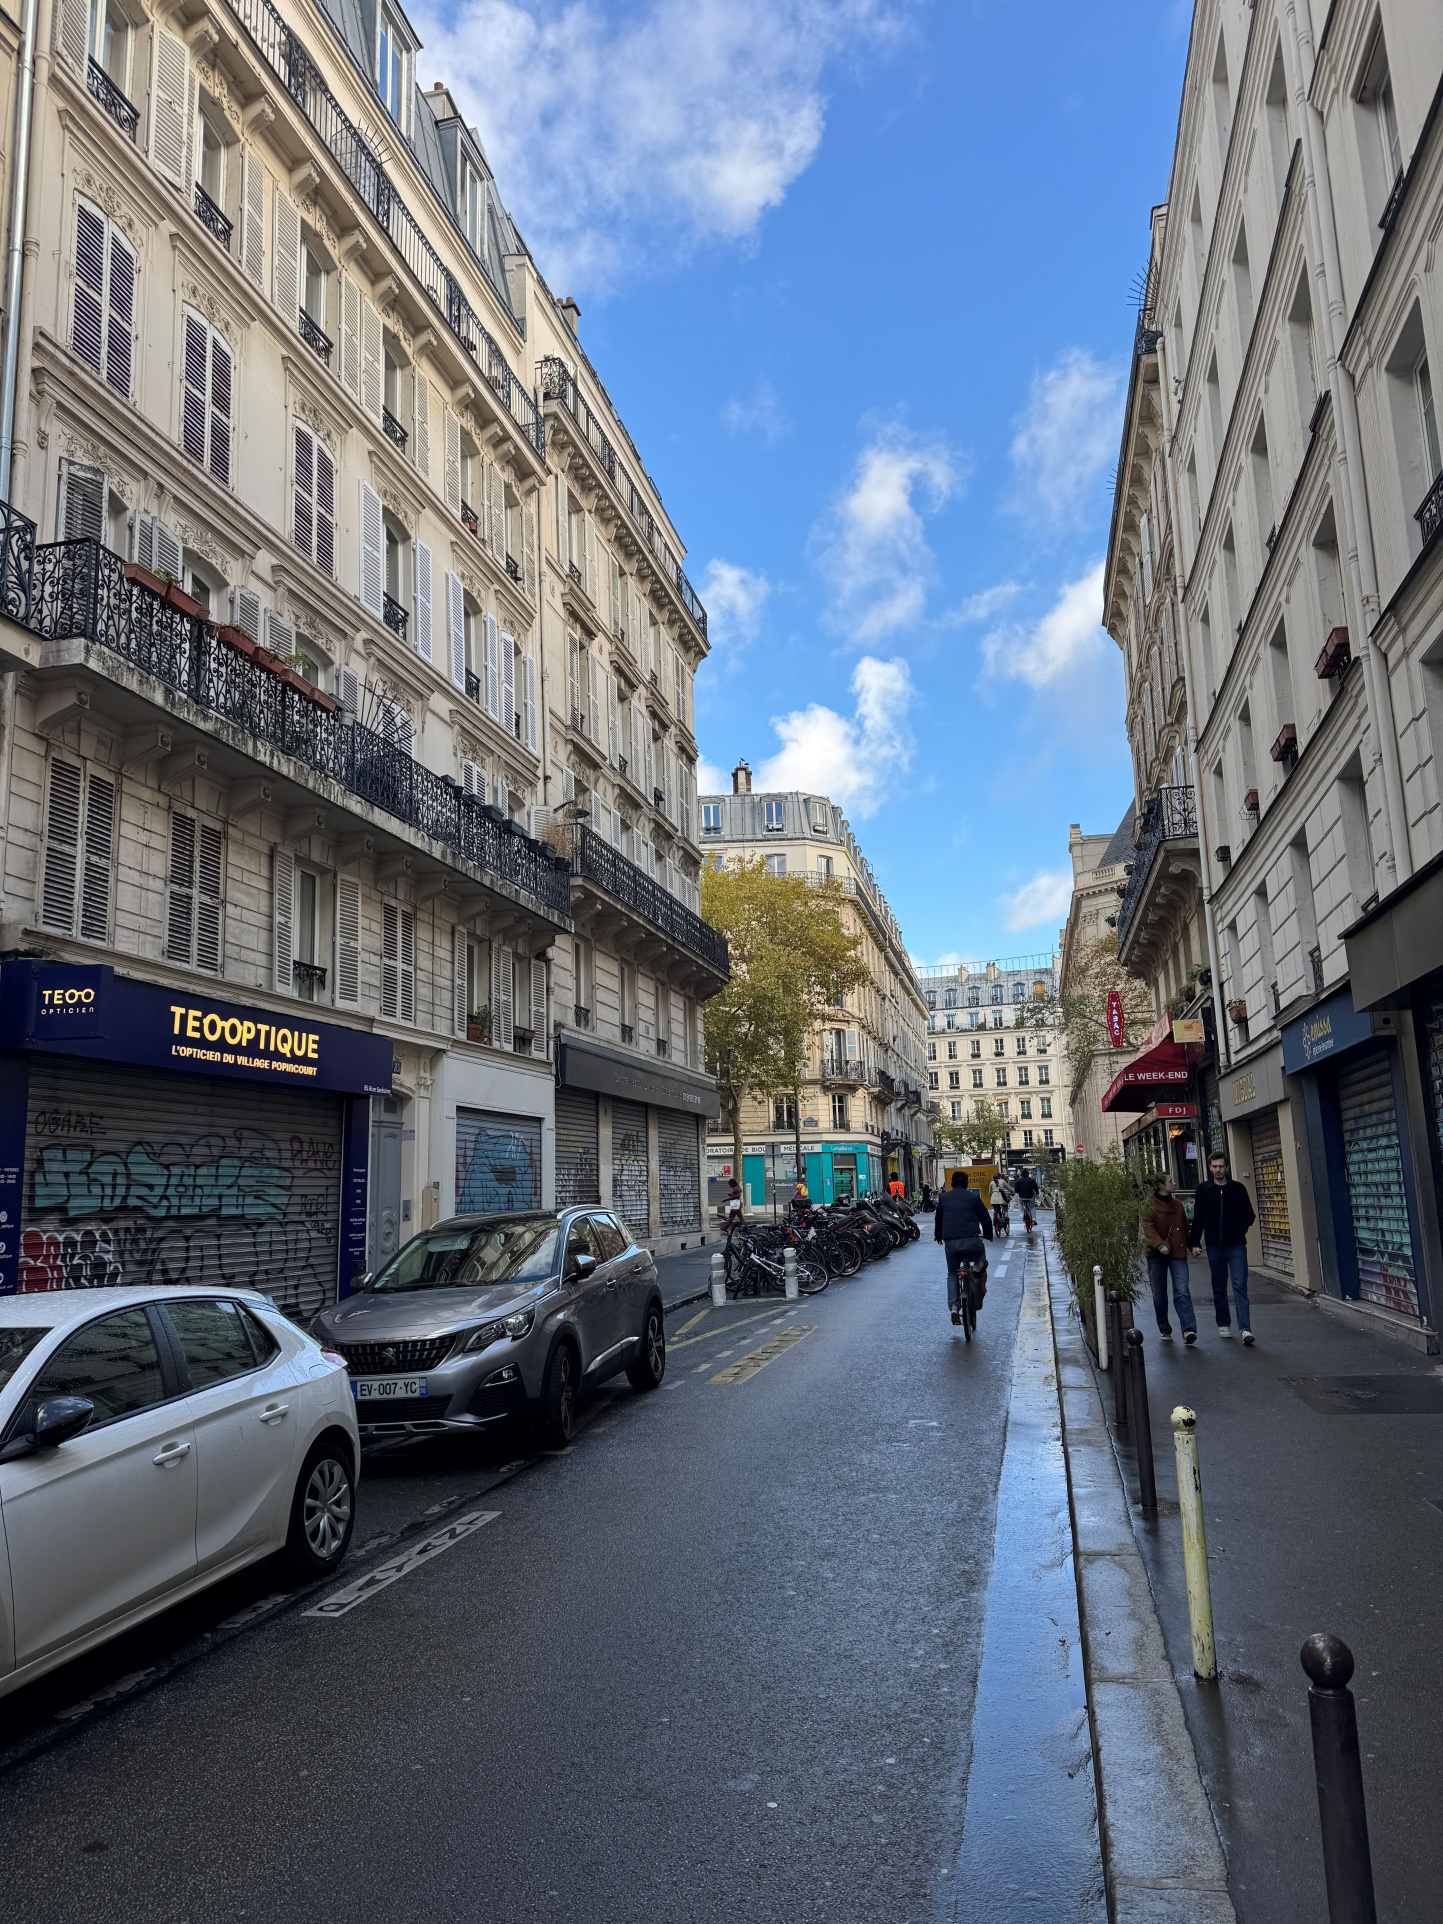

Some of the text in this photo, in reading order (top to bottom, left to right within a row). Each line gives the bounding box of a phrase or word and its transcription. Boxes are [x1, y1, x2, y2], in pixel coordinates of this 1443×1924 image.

[42, 988, 95, 1005] TEOO
[41, 1006, 95, 1015] OPTICIEN
[1111, 1001, 1120, 1036] TABAC
[170, 1005, 320, 1059] TEOOPTIQUE
[172, 1045, 317, 1076] L'OPTICIEN DU VILLAGE POPINCOURT
[1124, 1071, 1188, 1081] LE WEEK-END
[1168, 1107, 1187, 1115] FDJ
[360, 1381, 417, 1397] EV-007-YC
[317, 1513, 488, 1613] PAYANT
